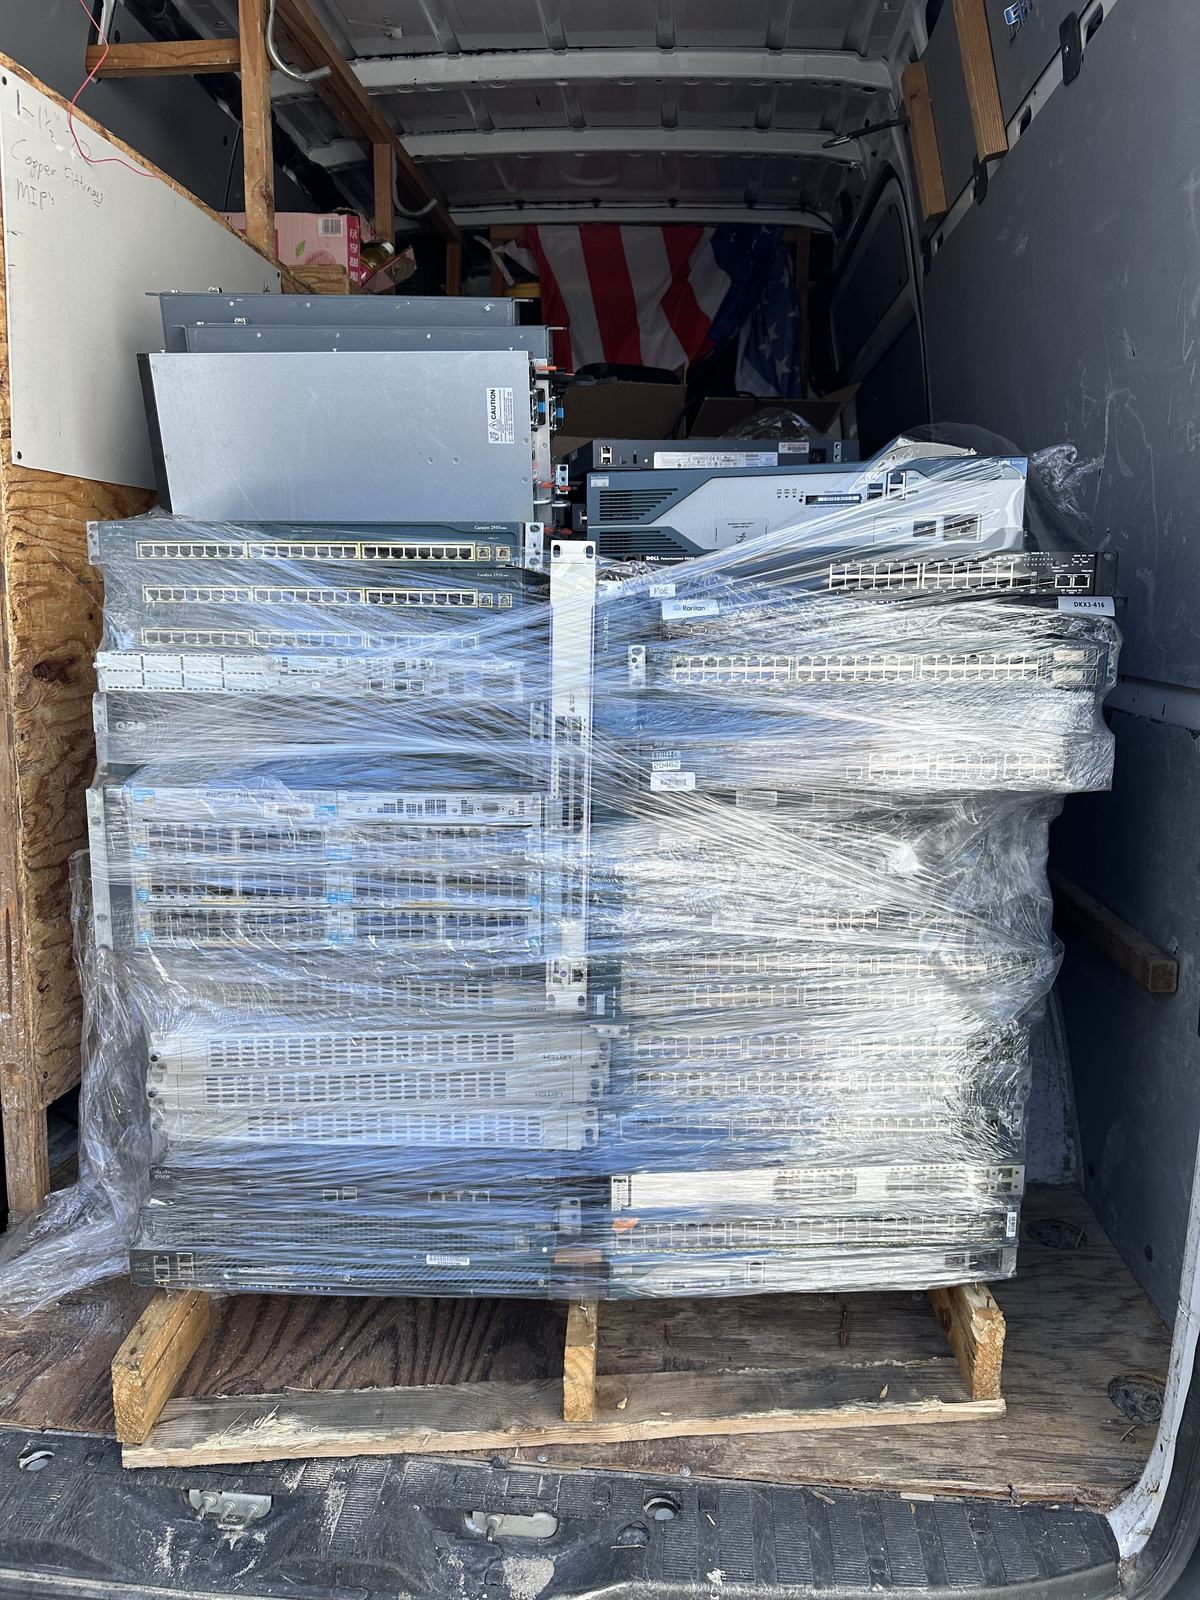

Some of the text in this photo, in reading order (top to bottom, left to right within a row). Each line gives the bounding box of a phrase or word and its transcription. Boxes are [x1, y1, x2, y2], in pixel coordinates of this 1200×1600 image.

[11, 139, 57, 181] Copper
[653, 587, 670, 595] PoE
[682, 604, 706, 612] Raritan
[1073, 601, 1105, 609] DKX3-416
[653, 762, 680, 770] 20462
